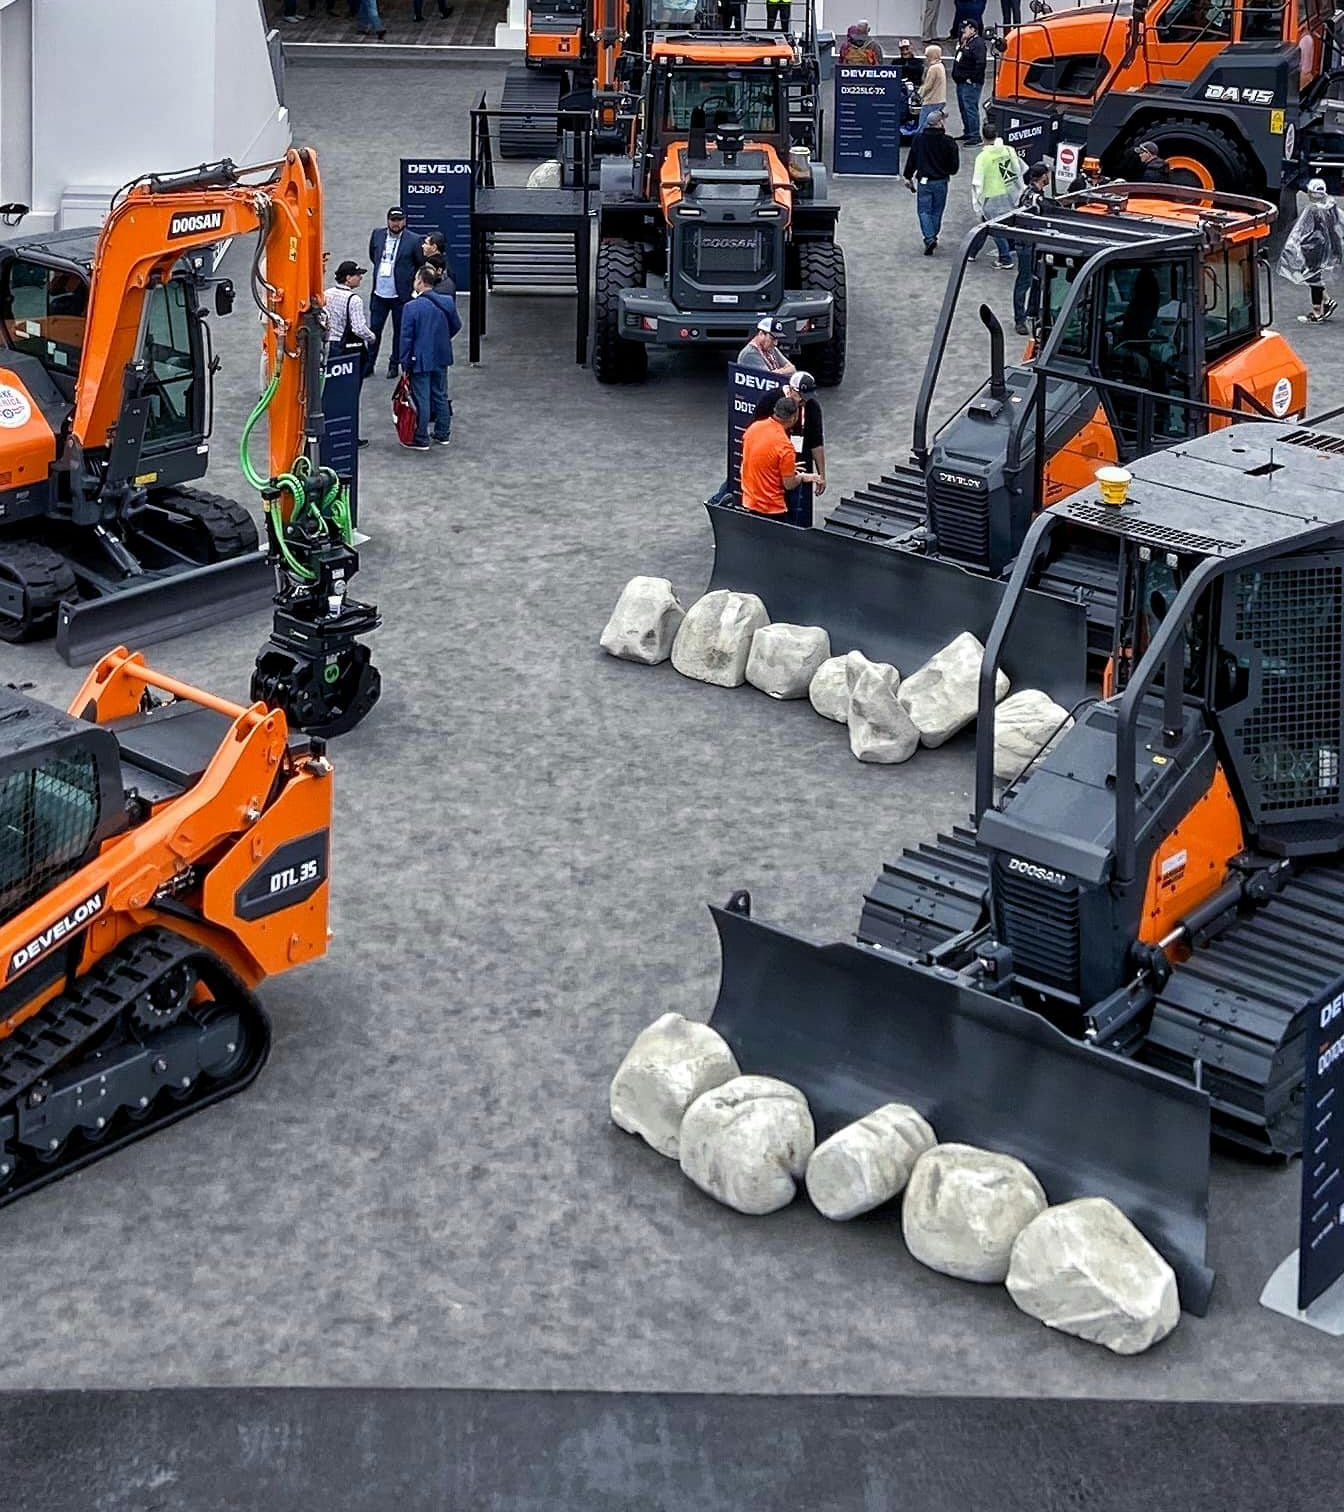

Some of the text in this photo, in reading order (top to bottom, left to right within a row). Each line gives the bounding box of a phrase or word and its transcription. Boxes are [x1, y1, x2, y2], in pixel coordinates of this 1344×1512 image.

[841, 69, 897, 79] DEVELON
[1242, 88, 1275, 105] 45
[1008, 126, 1042, 143] DEVELON
[171, 211, 223, 235] DOOSAN
[270, 860, 318, 893] DTL 35
[1008, 858, 1066, 885] DOOSAN
[13, 894, 102, 970] DEVELON
